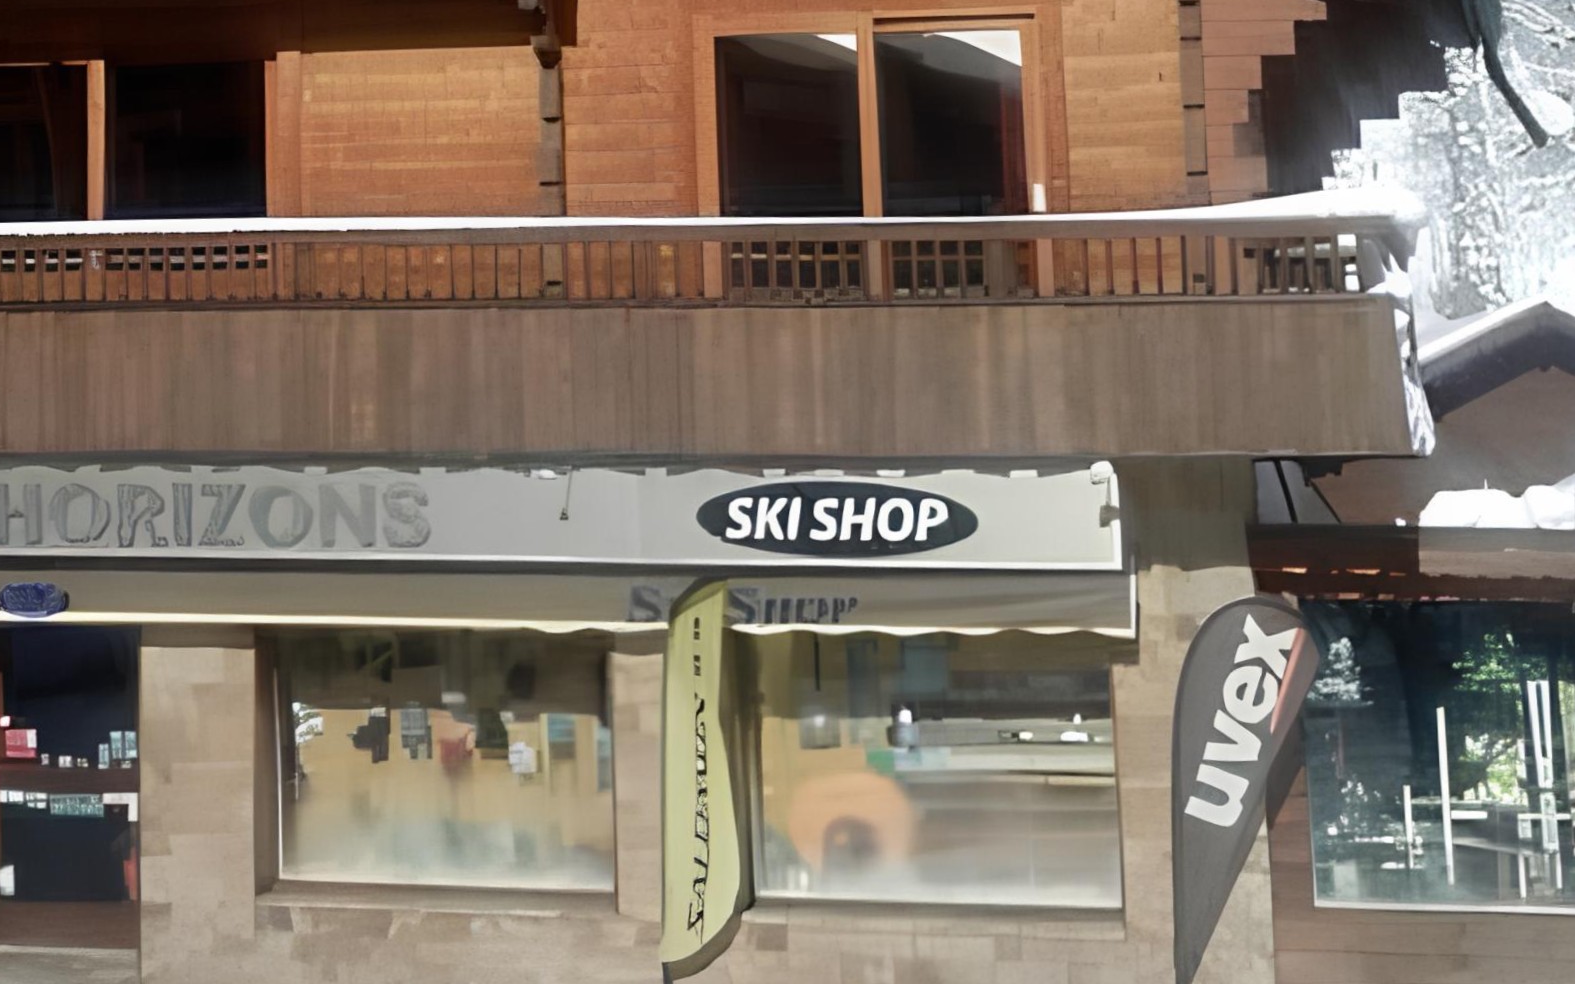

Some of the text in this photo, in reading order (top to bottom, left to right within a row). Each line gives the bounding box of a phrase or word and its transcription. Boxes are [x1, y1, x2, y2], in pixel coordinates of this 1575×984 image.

[725, 496, 950, 542] SKI SHOP
[1184, 613, 1300, 828] uvex
